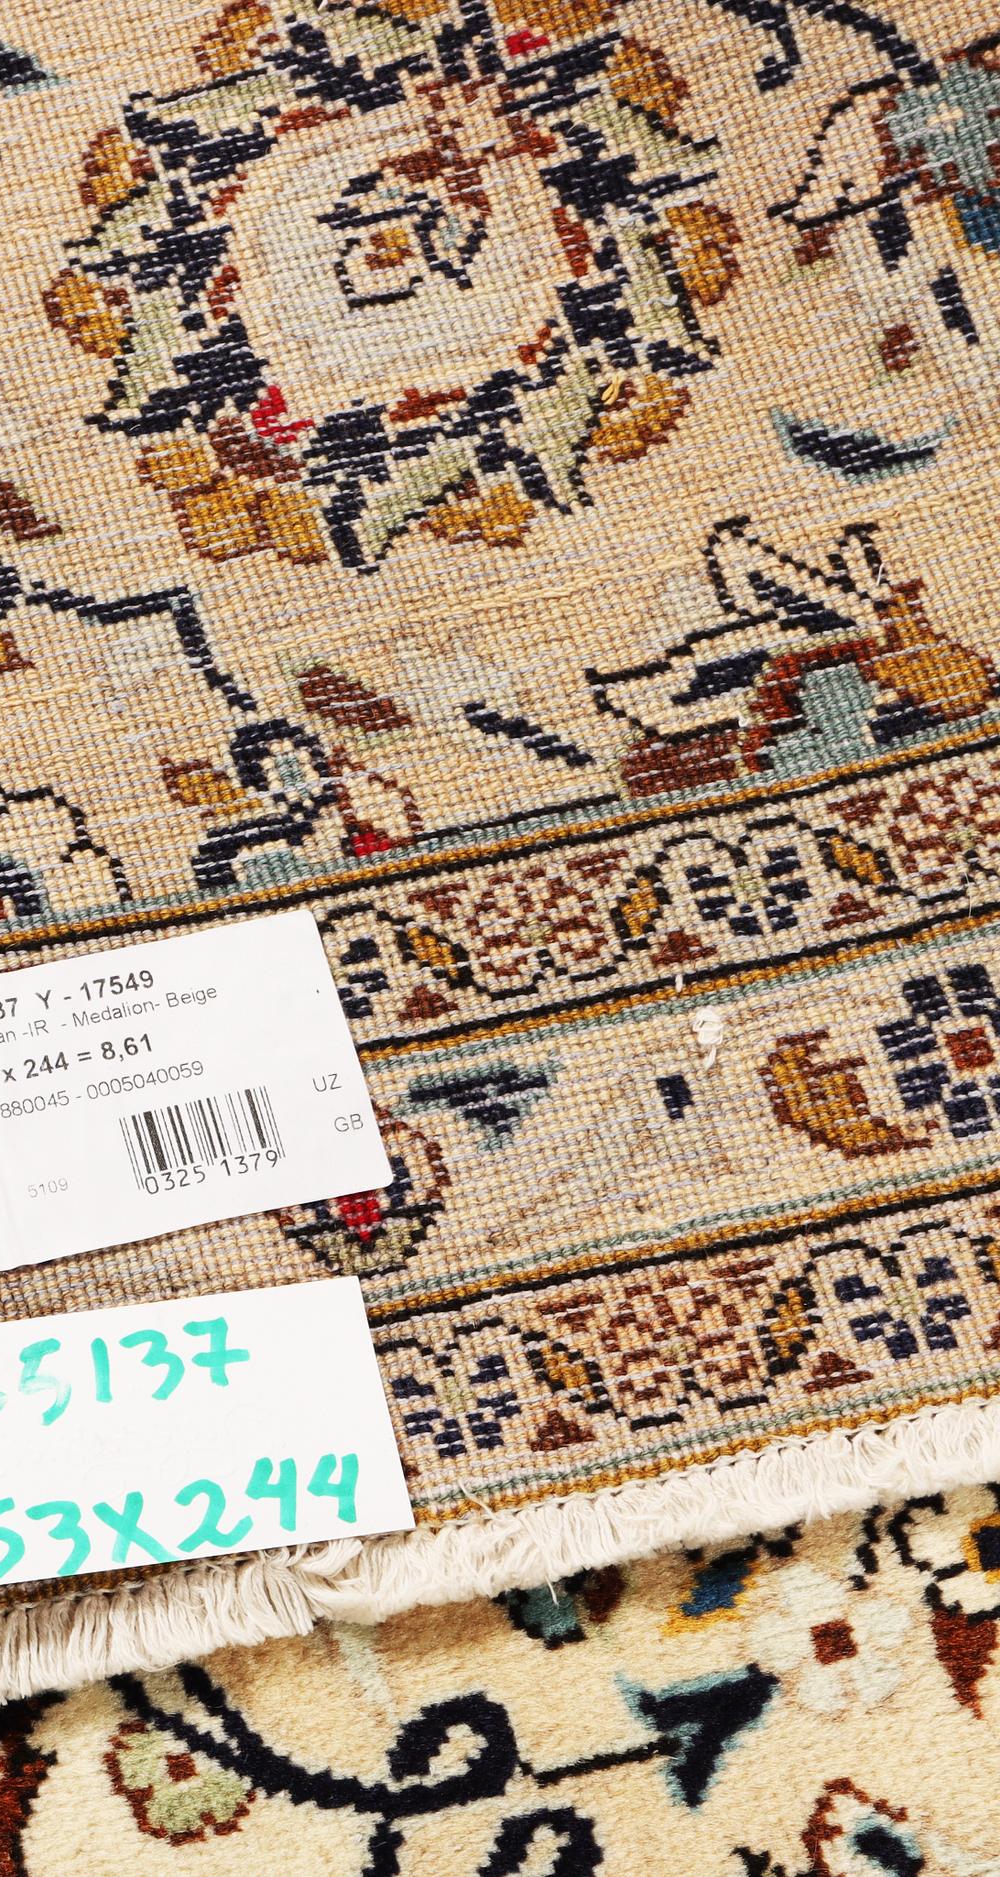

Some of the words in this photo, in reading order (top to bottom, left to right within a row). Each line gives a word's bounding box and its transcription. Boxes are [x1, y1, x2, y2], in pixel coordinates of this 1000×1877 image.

[35, 989, 52, 1010] Y
[80, 970, 155, 1001] 17549
[165, 987, 218, 1009] Beige
[2, 1067, 17, 1083] x
[23, 1051, 69, 1079] 244
[100, 1033, 153, 1062] 8,61
[86, 1060, 204, 1099] 0005040059
[312, 1073, 342, 1092] UZ
[333, 1113, 364, 1132] GB
[144, 1165, 206, 1195] 0325
[220, 1150, 278, 1176] 1379
[27, 1178, 69, 1199] 5109
